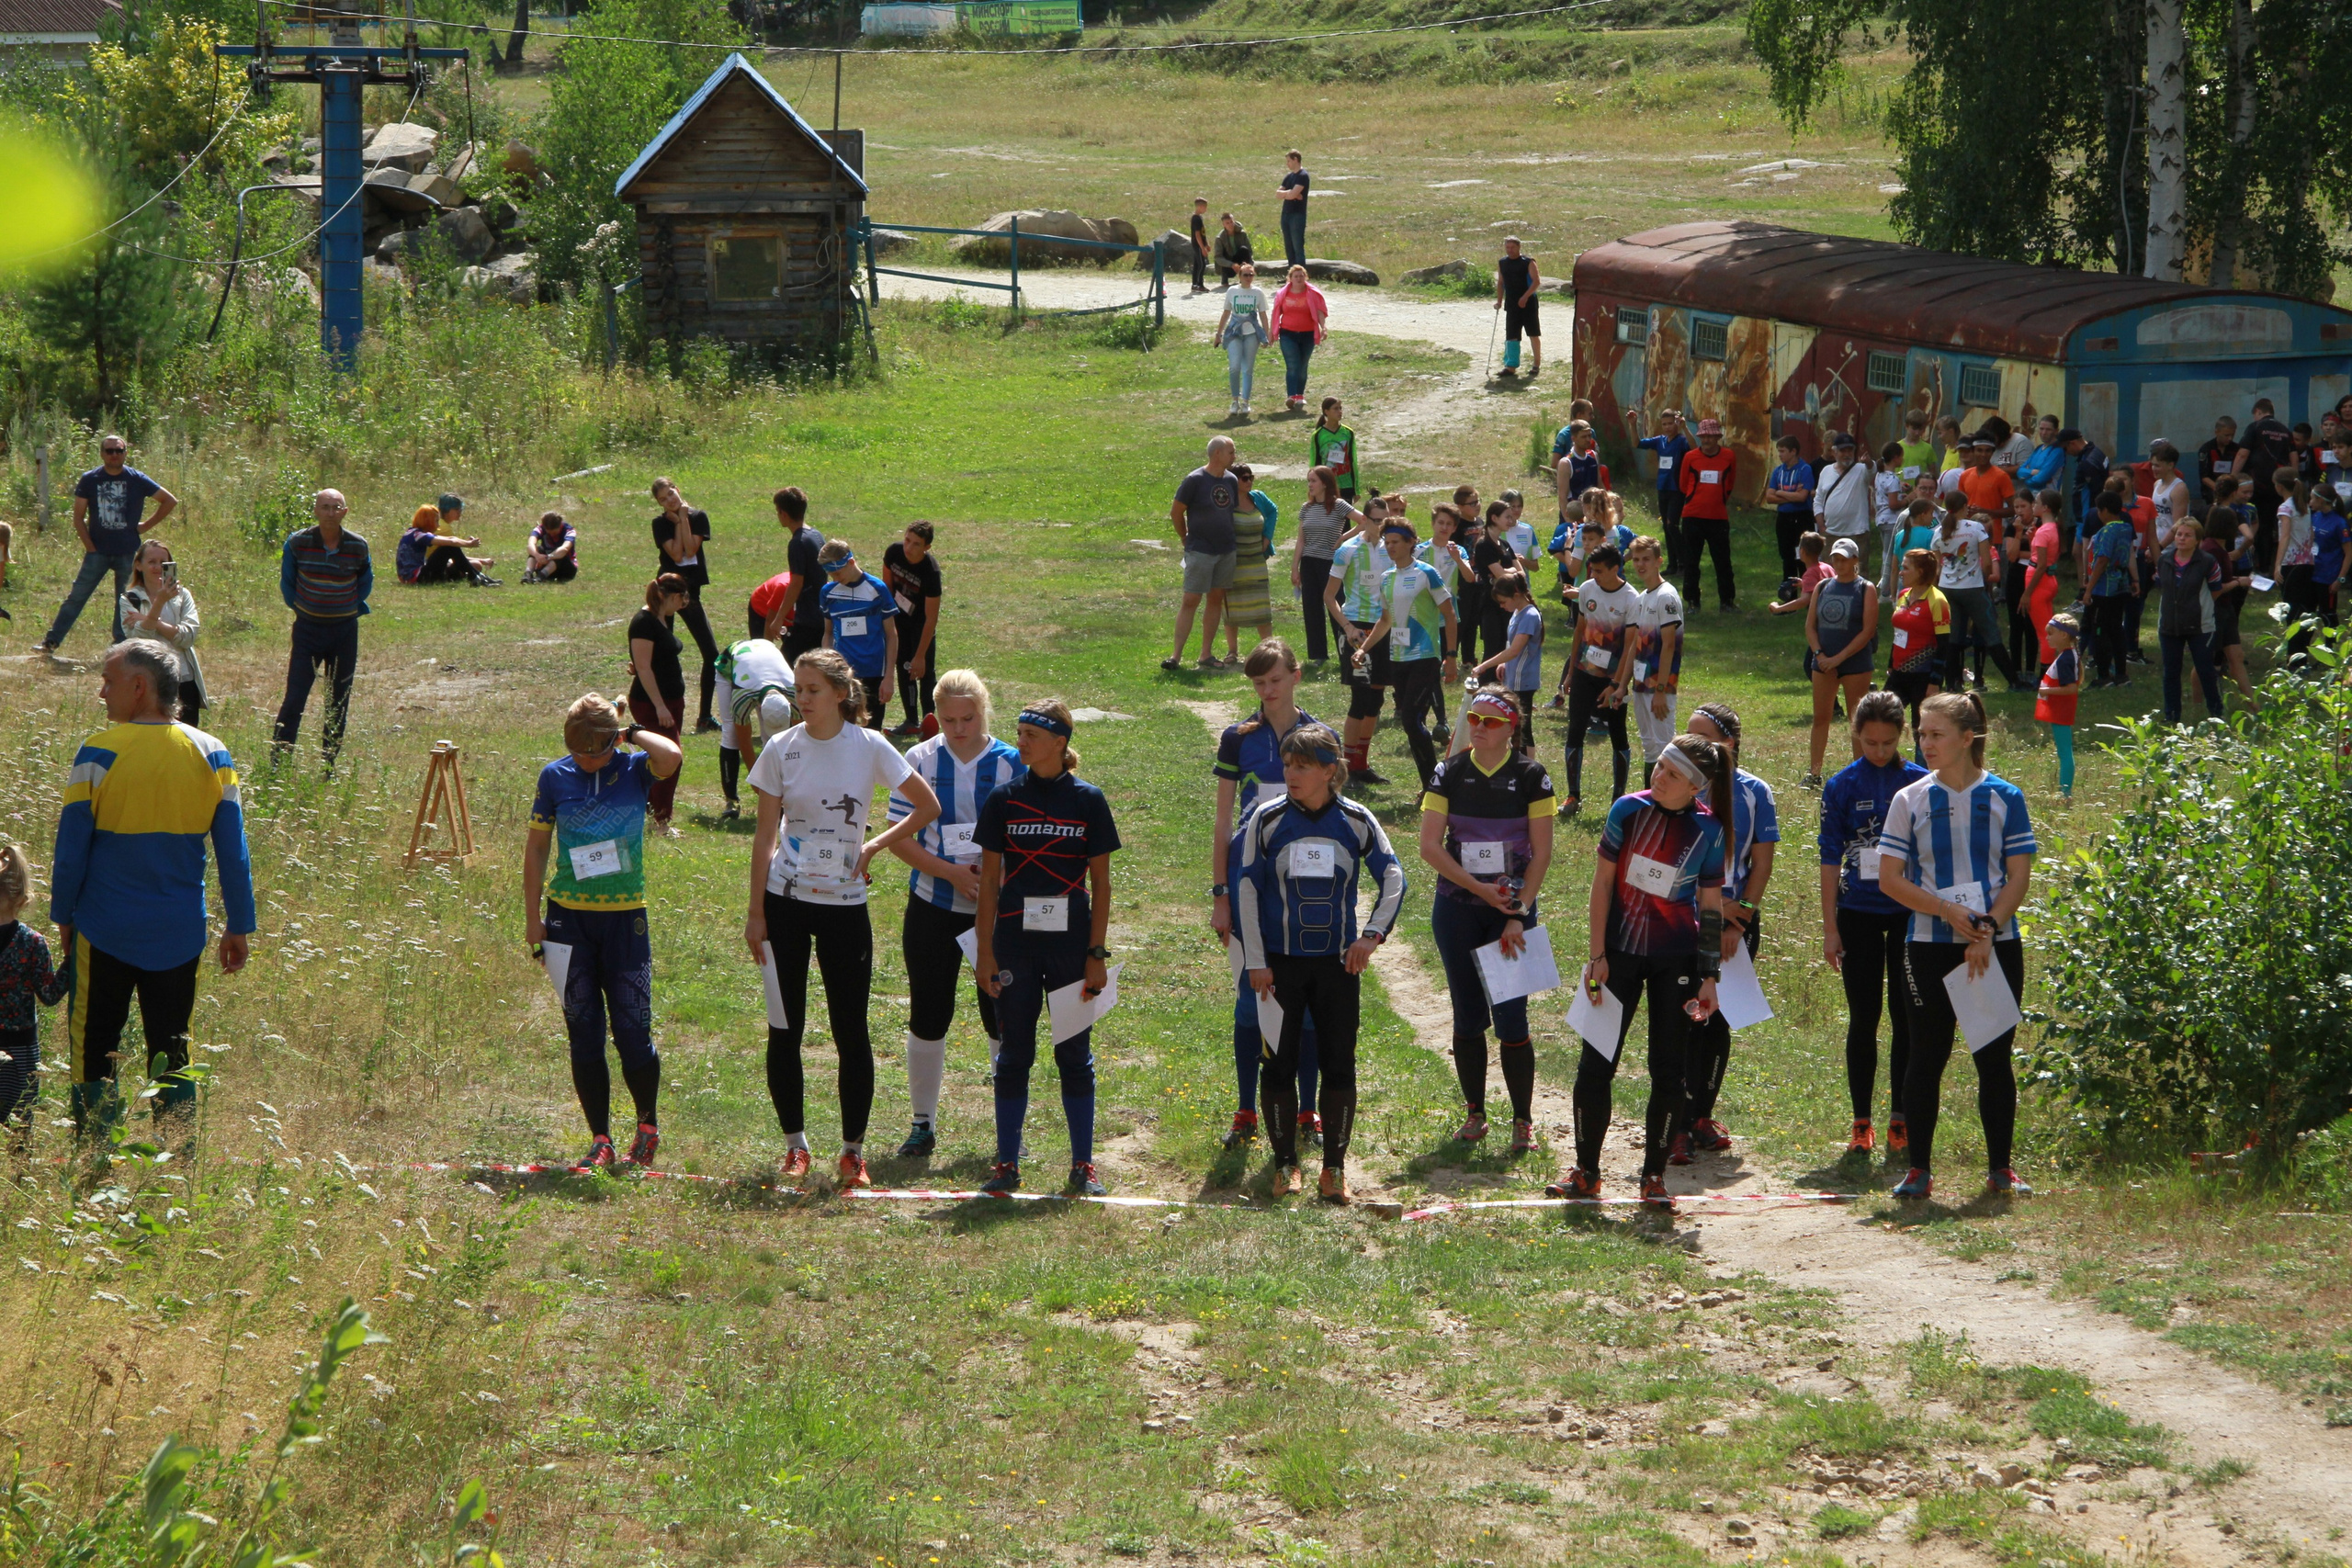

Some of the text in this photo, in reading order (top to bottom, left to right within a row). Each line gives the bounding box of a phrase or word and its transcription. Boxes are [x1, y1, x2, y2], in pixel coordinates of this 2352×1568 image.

[972, 3, 1013, 17] МИНСПОРТ
[785, 751, 801, 761] 2021
[958, 831, 972, 840] 65
[1007, 824, 1085, 837] noname
[589, 851, 603, 862] 59
[819, 849, 832, 859] 58
[1307, 850, 1320, 860] 56
[1479, 849, 1491, 859] 62
[1648, 867, 1663, 879] 53
[1955, 893, 1968, 904] 51
[1042, 905, 1055, 915] 57
[1663, 1111, 1672, 1139] NORD
